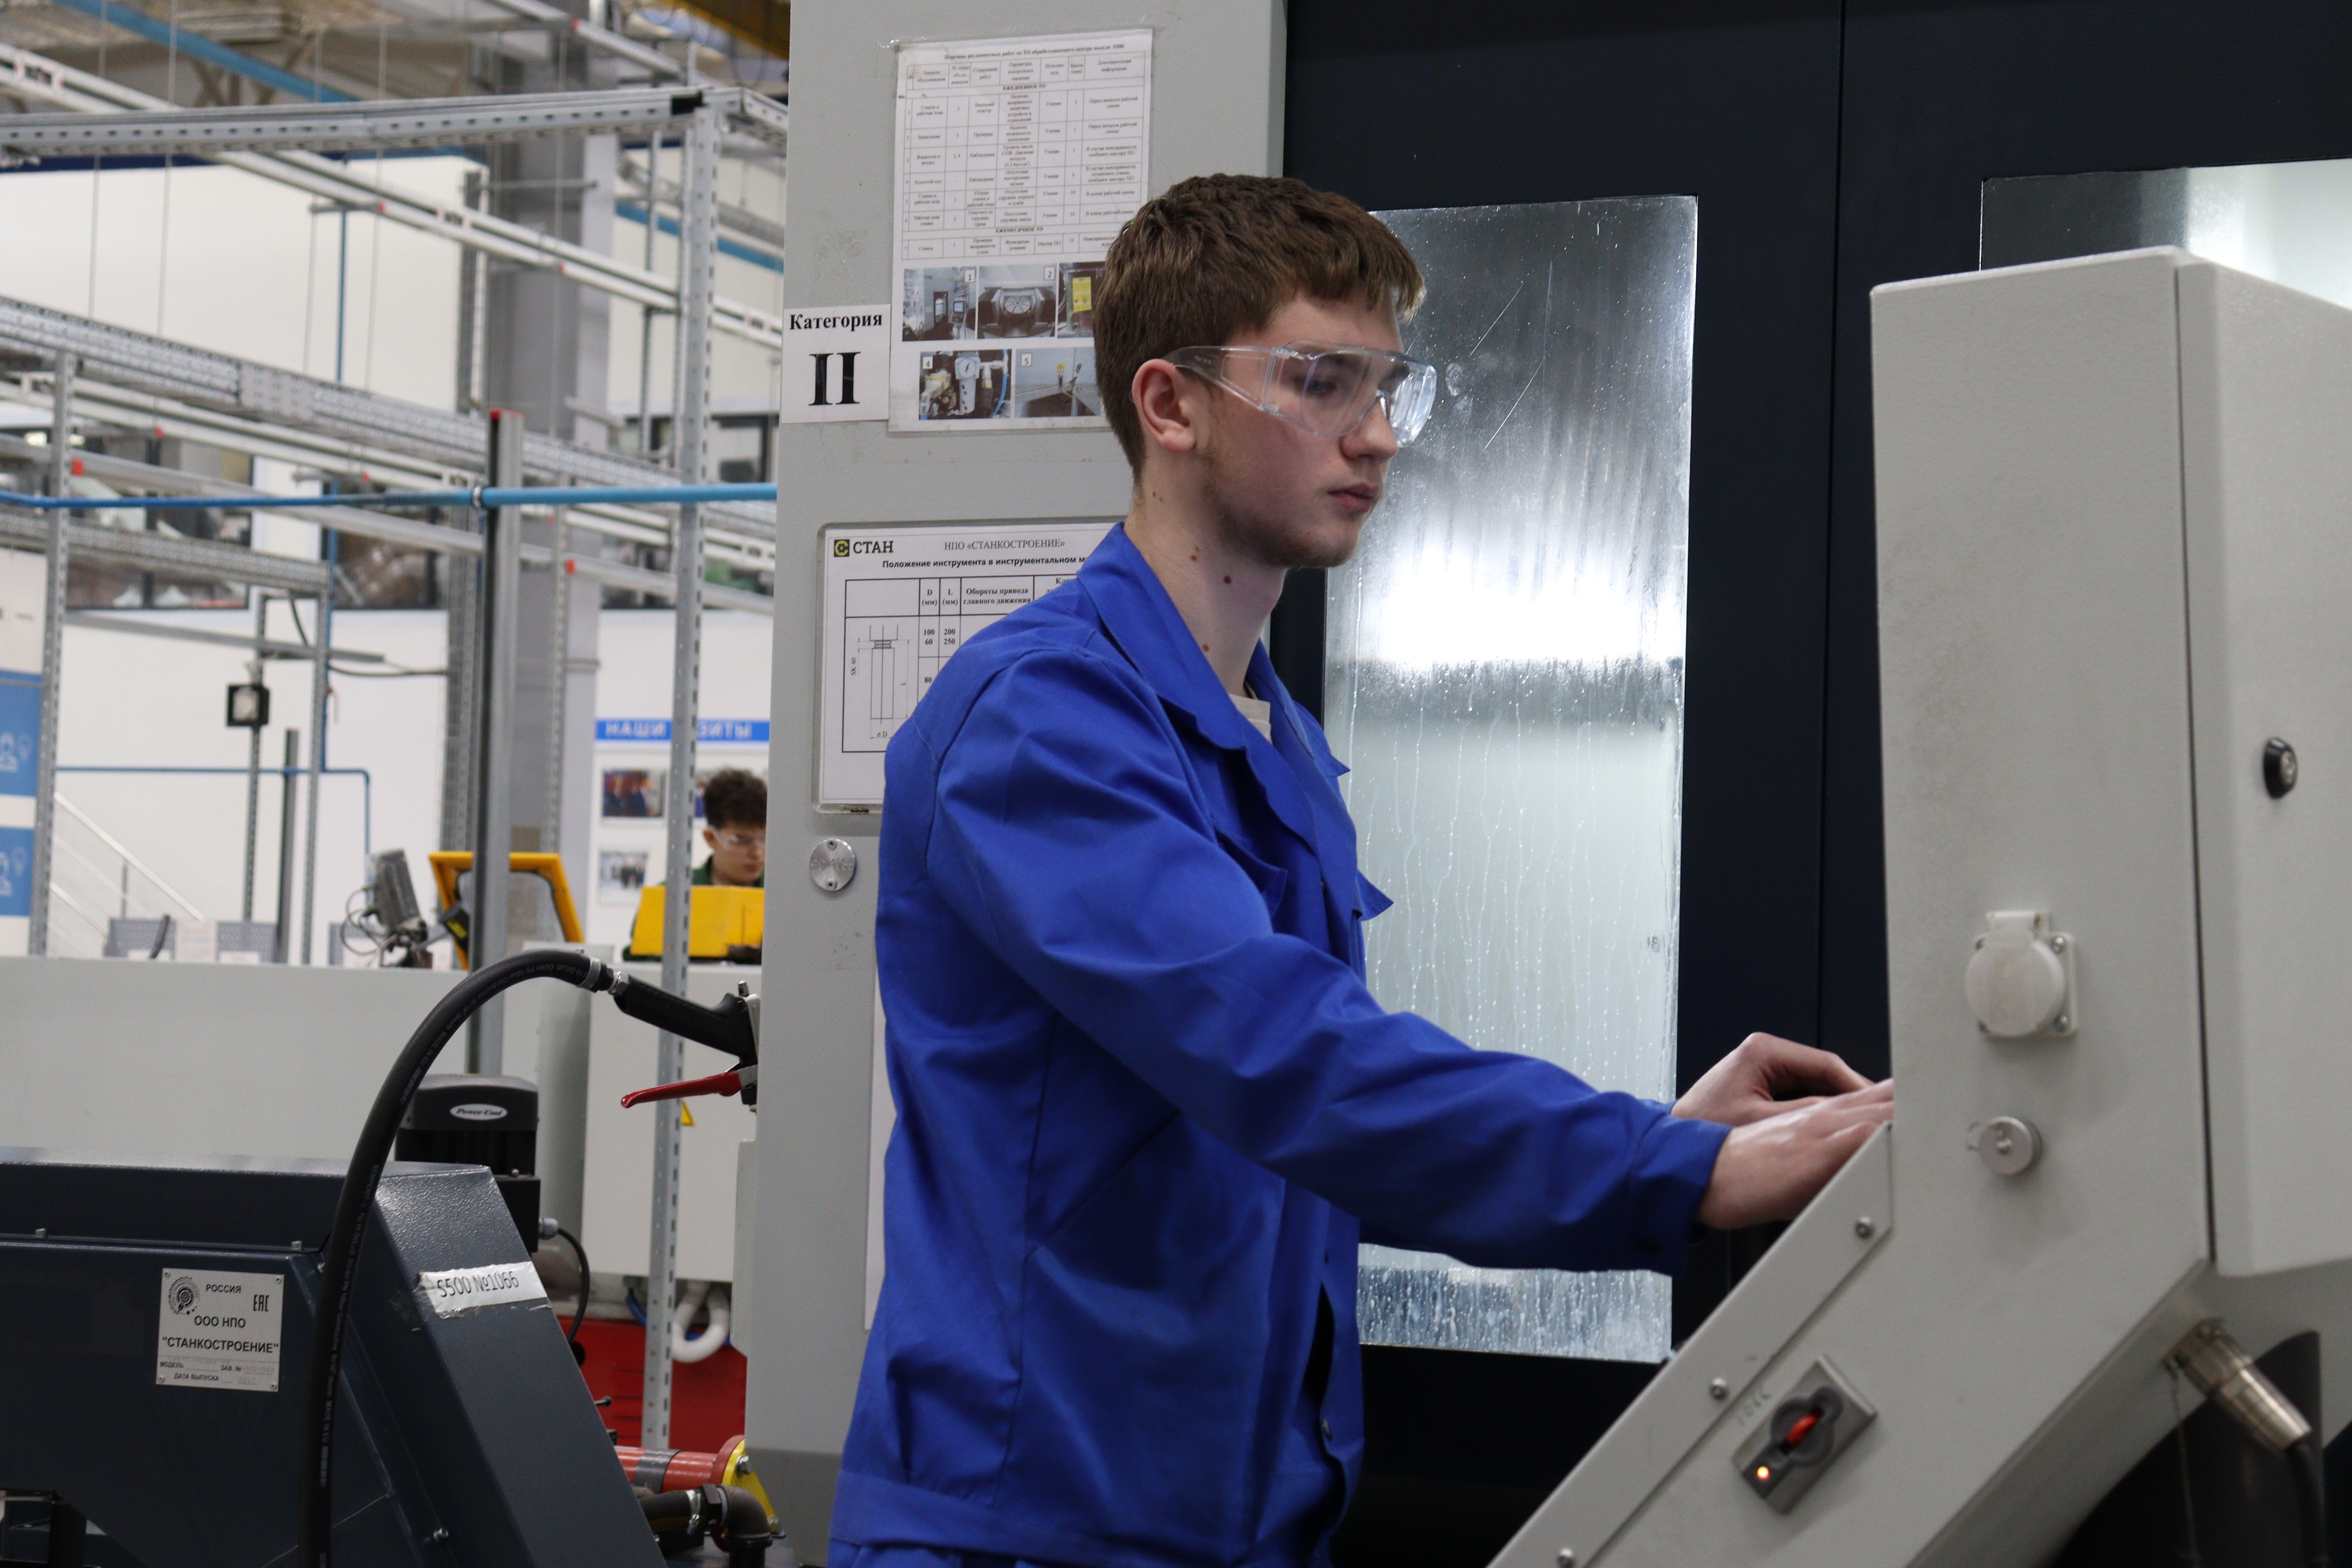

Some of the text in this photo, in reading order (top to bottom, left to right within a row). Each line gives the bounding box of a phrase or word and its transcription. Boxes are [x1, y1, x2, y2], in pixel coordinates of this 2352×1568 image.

[1047, 270, 1053, 278] 2
[790, 314, 882, 332] Категория
[808, 351, 861, 406] II
[853, 541, 894, 554] СТАН
[967, 539, 1065, 549] «СТАНКОСТРОЕНИЕ»
[933, 559, 986, 568] инструмента
[996, 557, 1076, 567] инструментальном
[851, 667, 856, 675] SK
[606, 722, 667, 737] НАШИ
[206, 1284, 241, 1293] РОССИЯ
[437, 1276, 472, 1297] S500
[194, 1315, 246, 1328] ООО НПО
[162, 1337, 279, 1353] "СТАНКОСТРОЕНИЕ"
